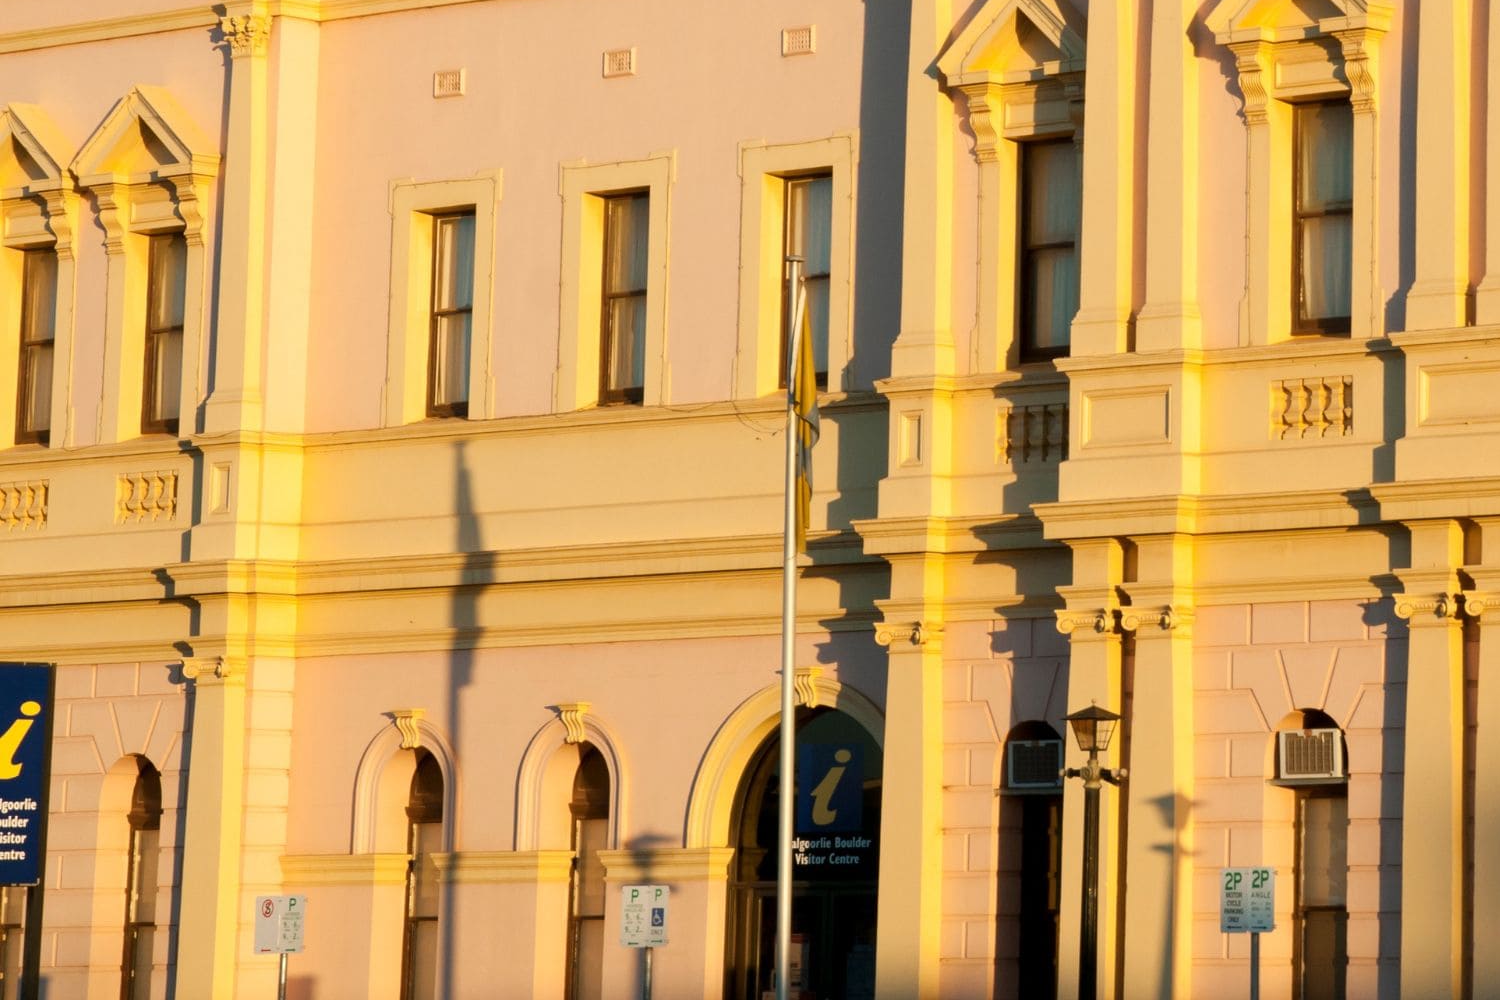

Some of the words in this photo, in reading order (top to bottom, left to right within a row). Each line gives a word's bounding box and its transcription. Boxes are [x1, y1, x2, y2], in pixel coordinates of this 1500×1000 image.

[834, 836, 871, 848] Boulder
[795, 852, 826, 865] Visitor
[829, 852, 860, 865] Centre
[1225, 872, 1242, 890] 2P
[1252, 870, 1269, 888] 2P
[631, 888, 639, 902] P
[655, 888, 662, 901] P
[1251, 891, 1271, 899] ANGLE
[288, 898, 297, 911] P
